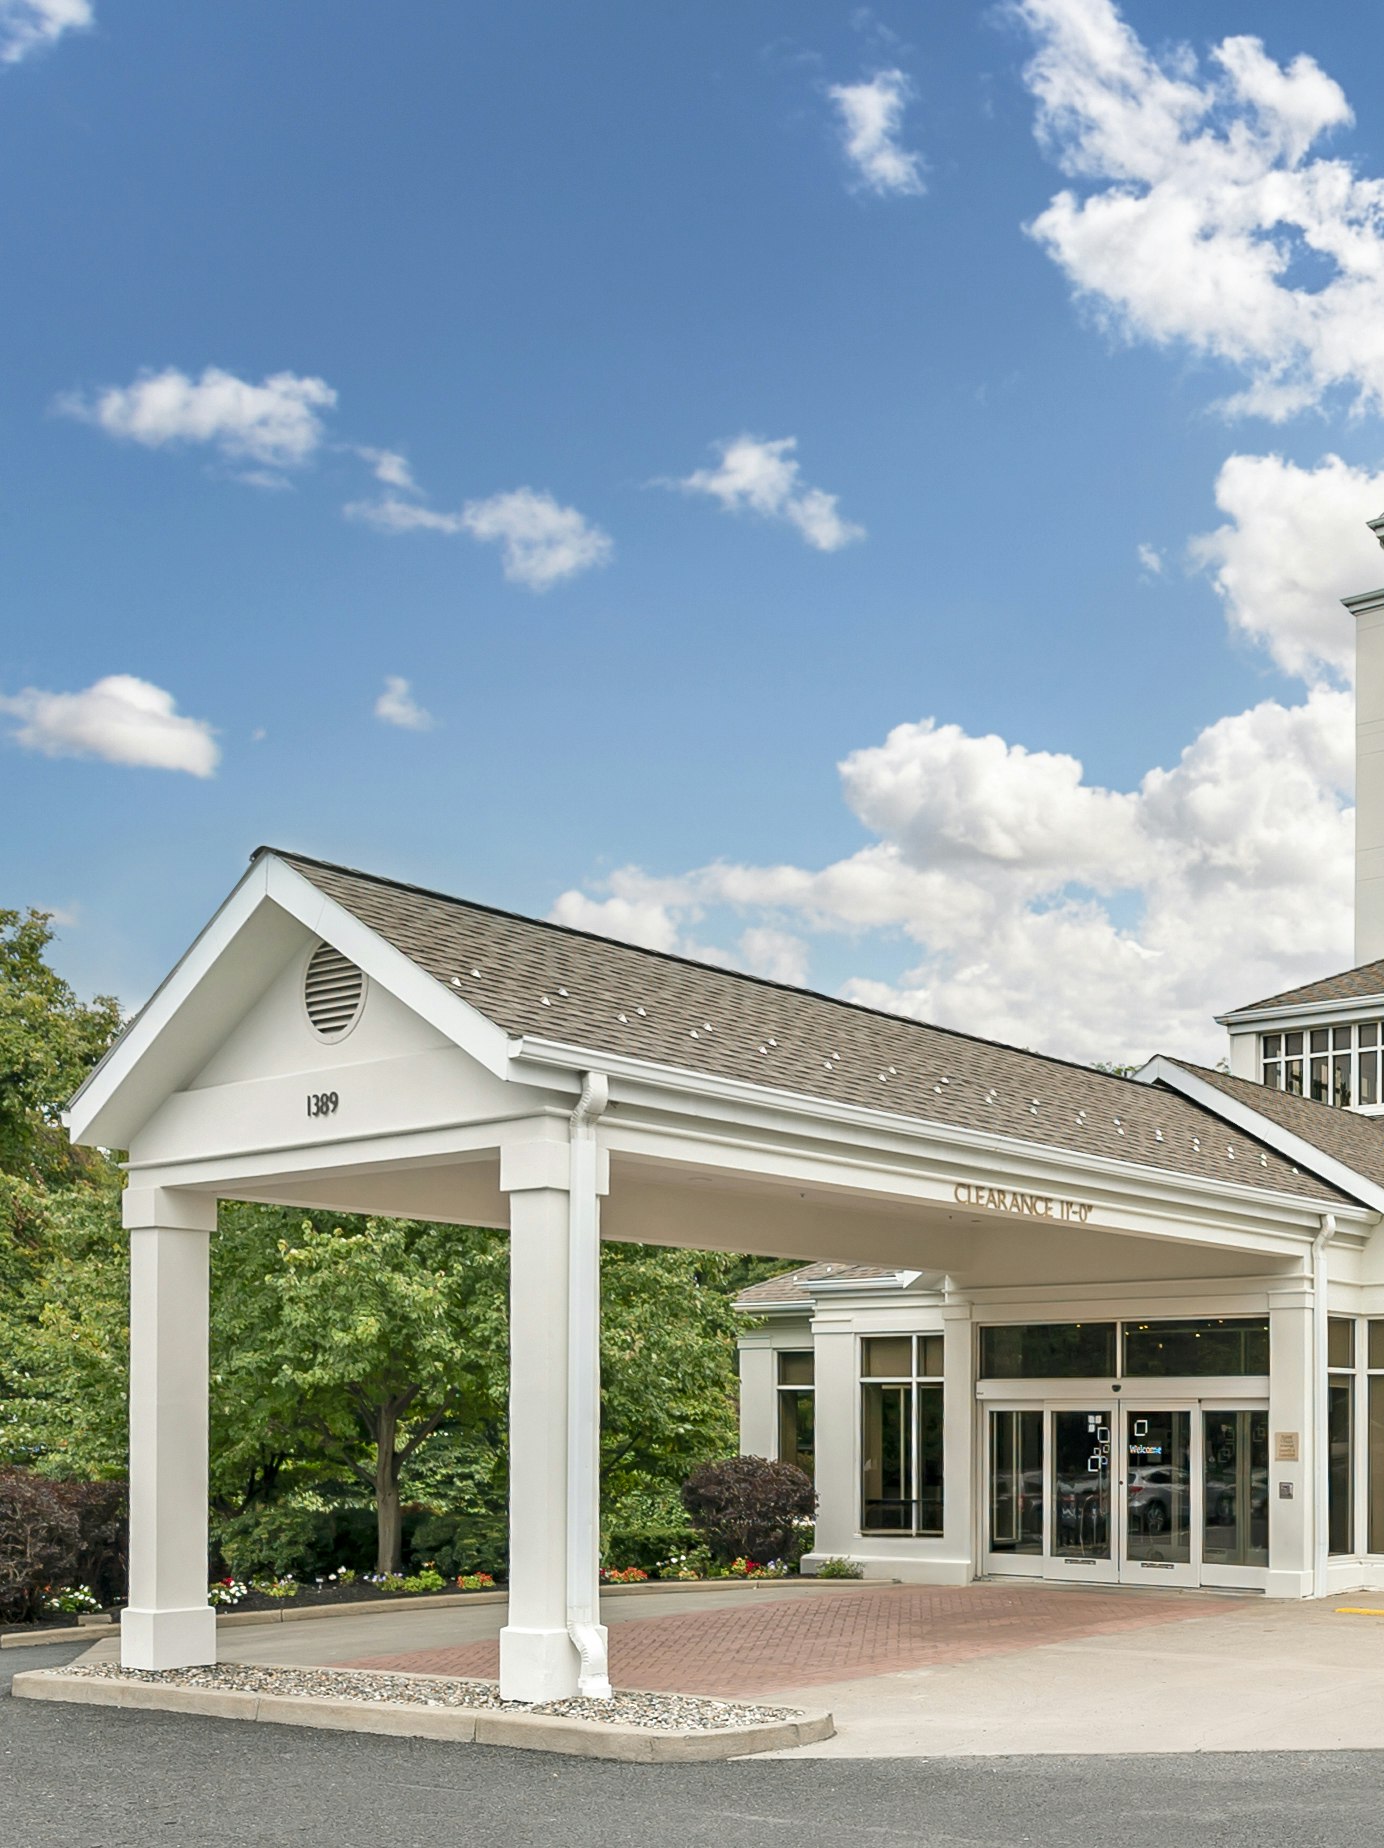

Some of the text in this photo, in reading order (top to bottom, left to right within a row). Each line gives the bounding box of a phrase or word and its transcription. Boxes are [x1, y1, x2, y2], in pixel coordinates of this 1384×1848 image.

[307, 1091, 339, 1117] 1389
[954, 1183, 1054, 1218] CLEARANCE
[1129, 1444, 1162, 1454] Welcome
